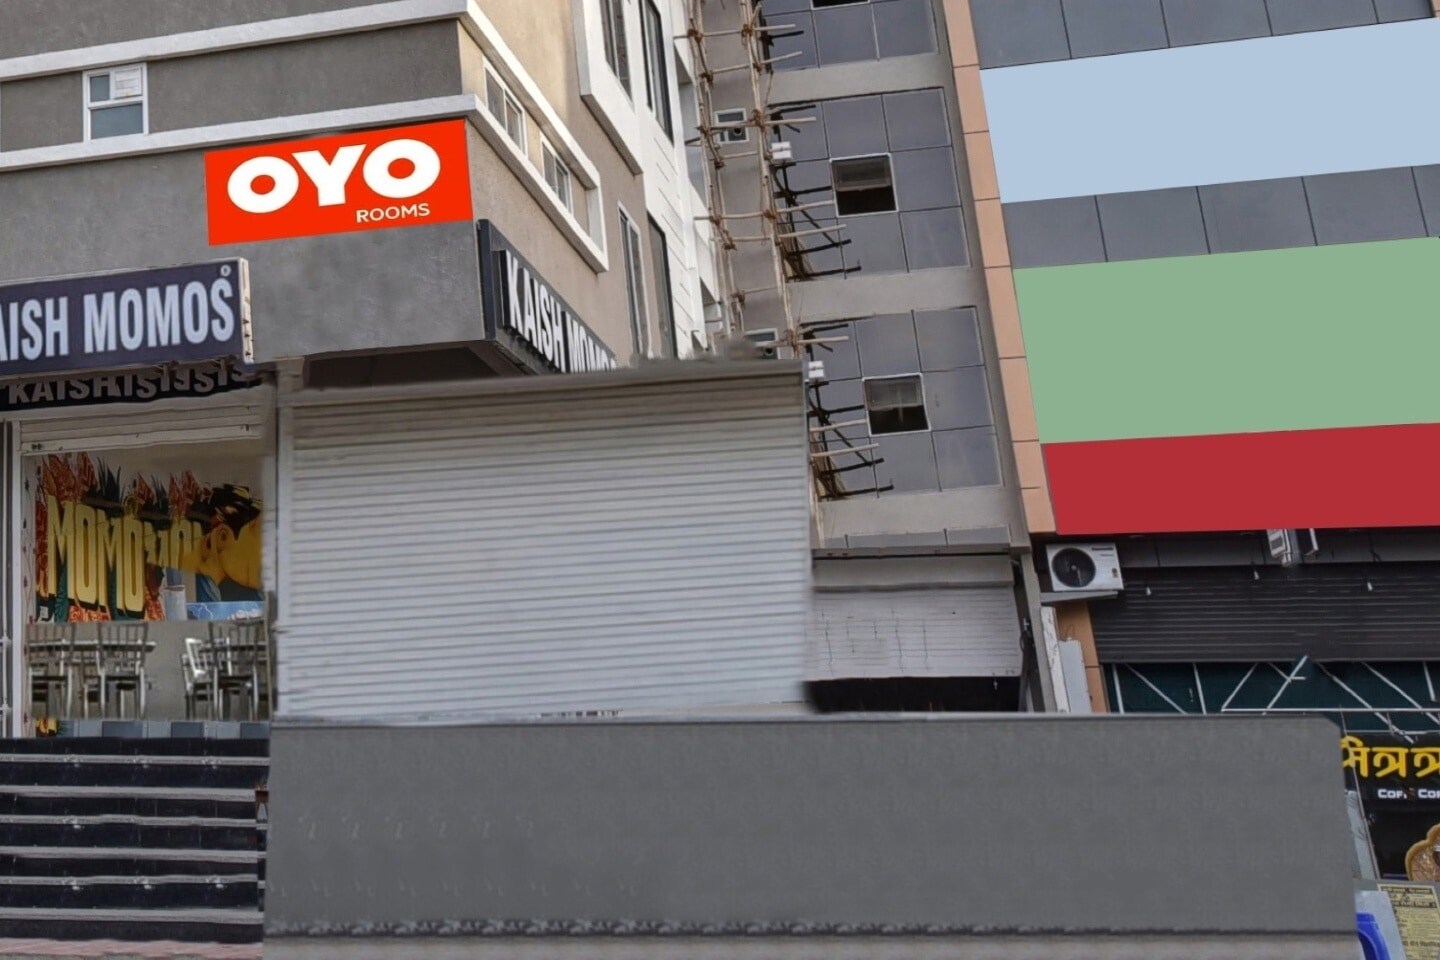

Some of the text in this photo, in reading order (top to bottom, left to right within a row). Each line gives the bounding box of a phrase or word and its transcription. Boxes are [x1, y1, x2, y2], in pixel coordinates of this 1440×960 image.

[227, 138, 441, 214] OYO
[356, 202, 431, 223] ROOMS
[83, 278, 235, 353] MOMOS
[505, 249, 566, 373] KAISH
